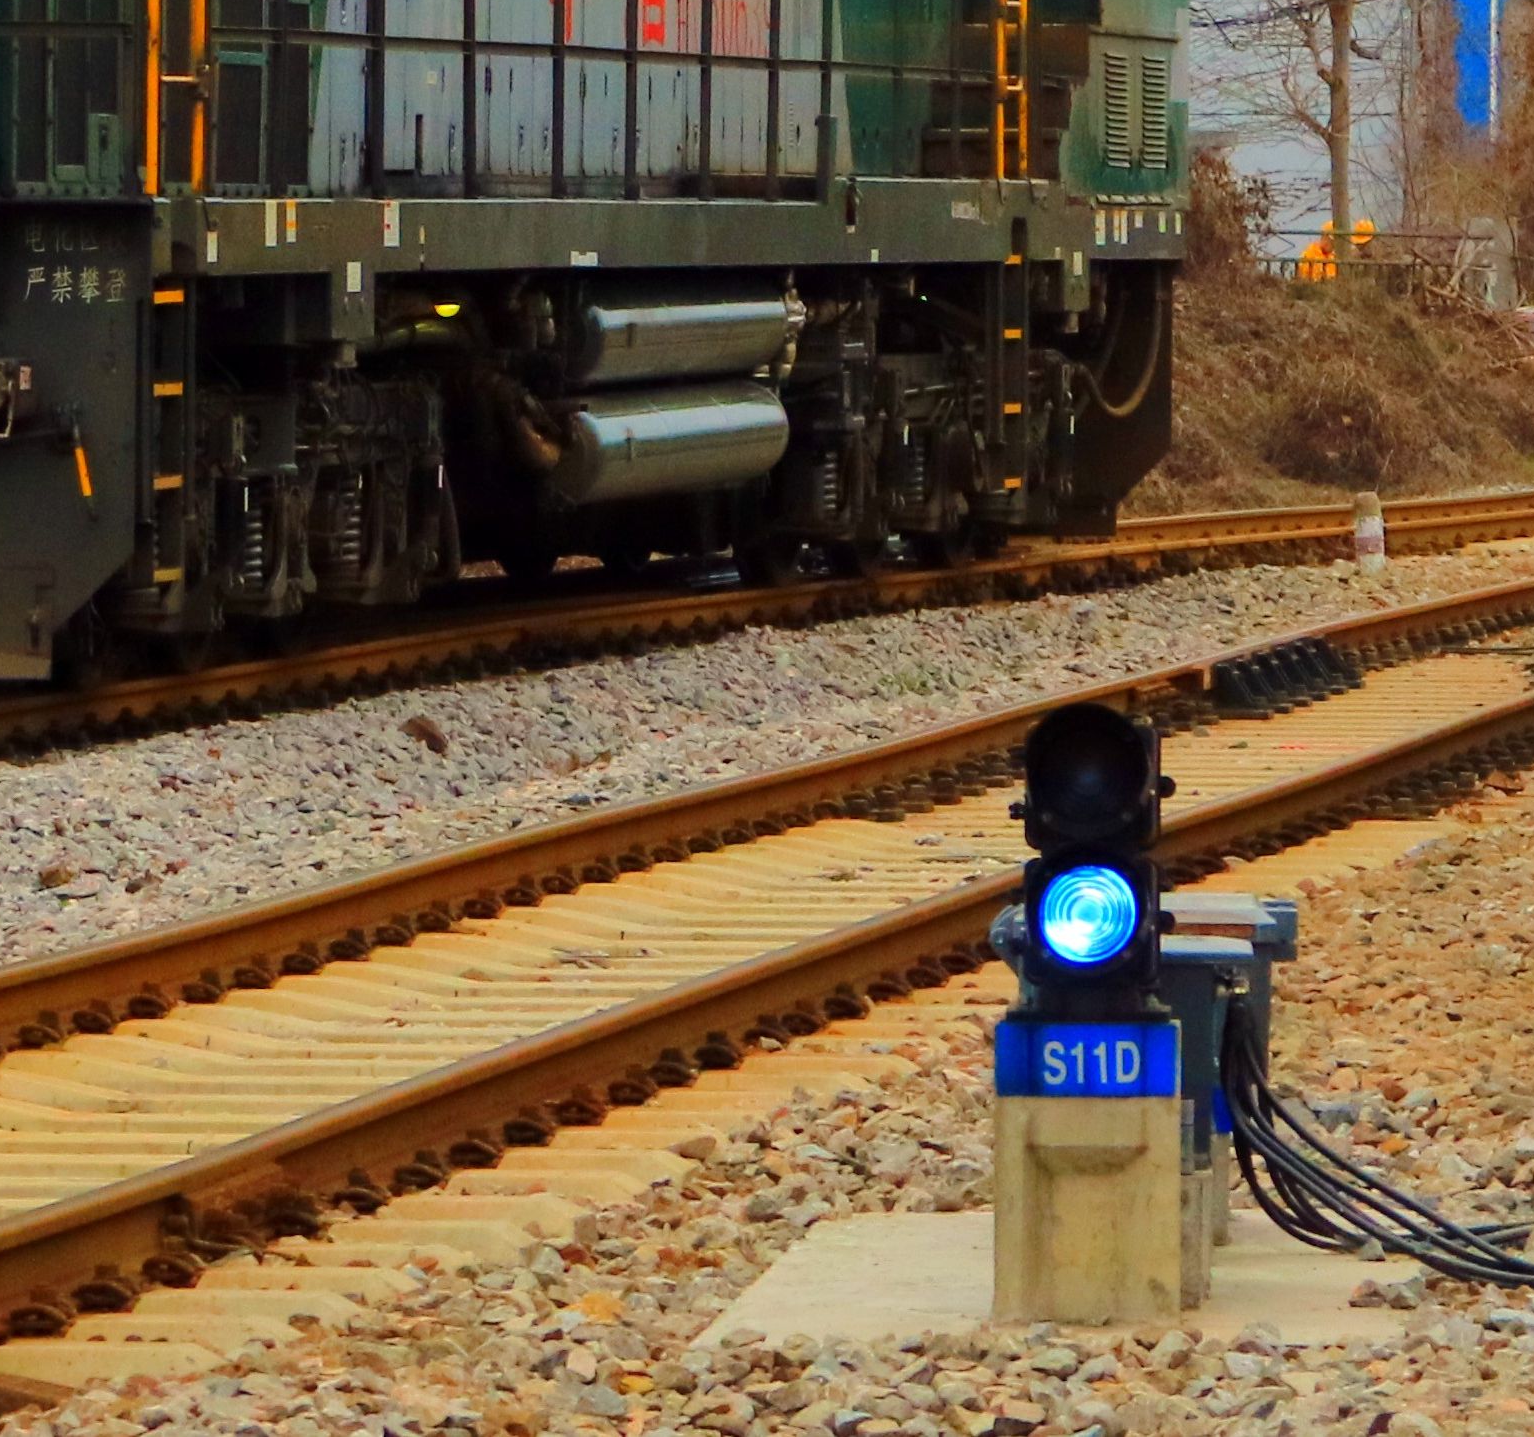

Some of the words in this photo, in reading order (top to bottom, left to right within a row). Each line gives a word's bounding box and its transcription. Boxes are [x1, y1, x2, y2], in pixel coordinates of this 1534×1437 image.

[23, 265, 128, 304] 严禁攀登
[1042, 1040, 1142, 1086] S11D
